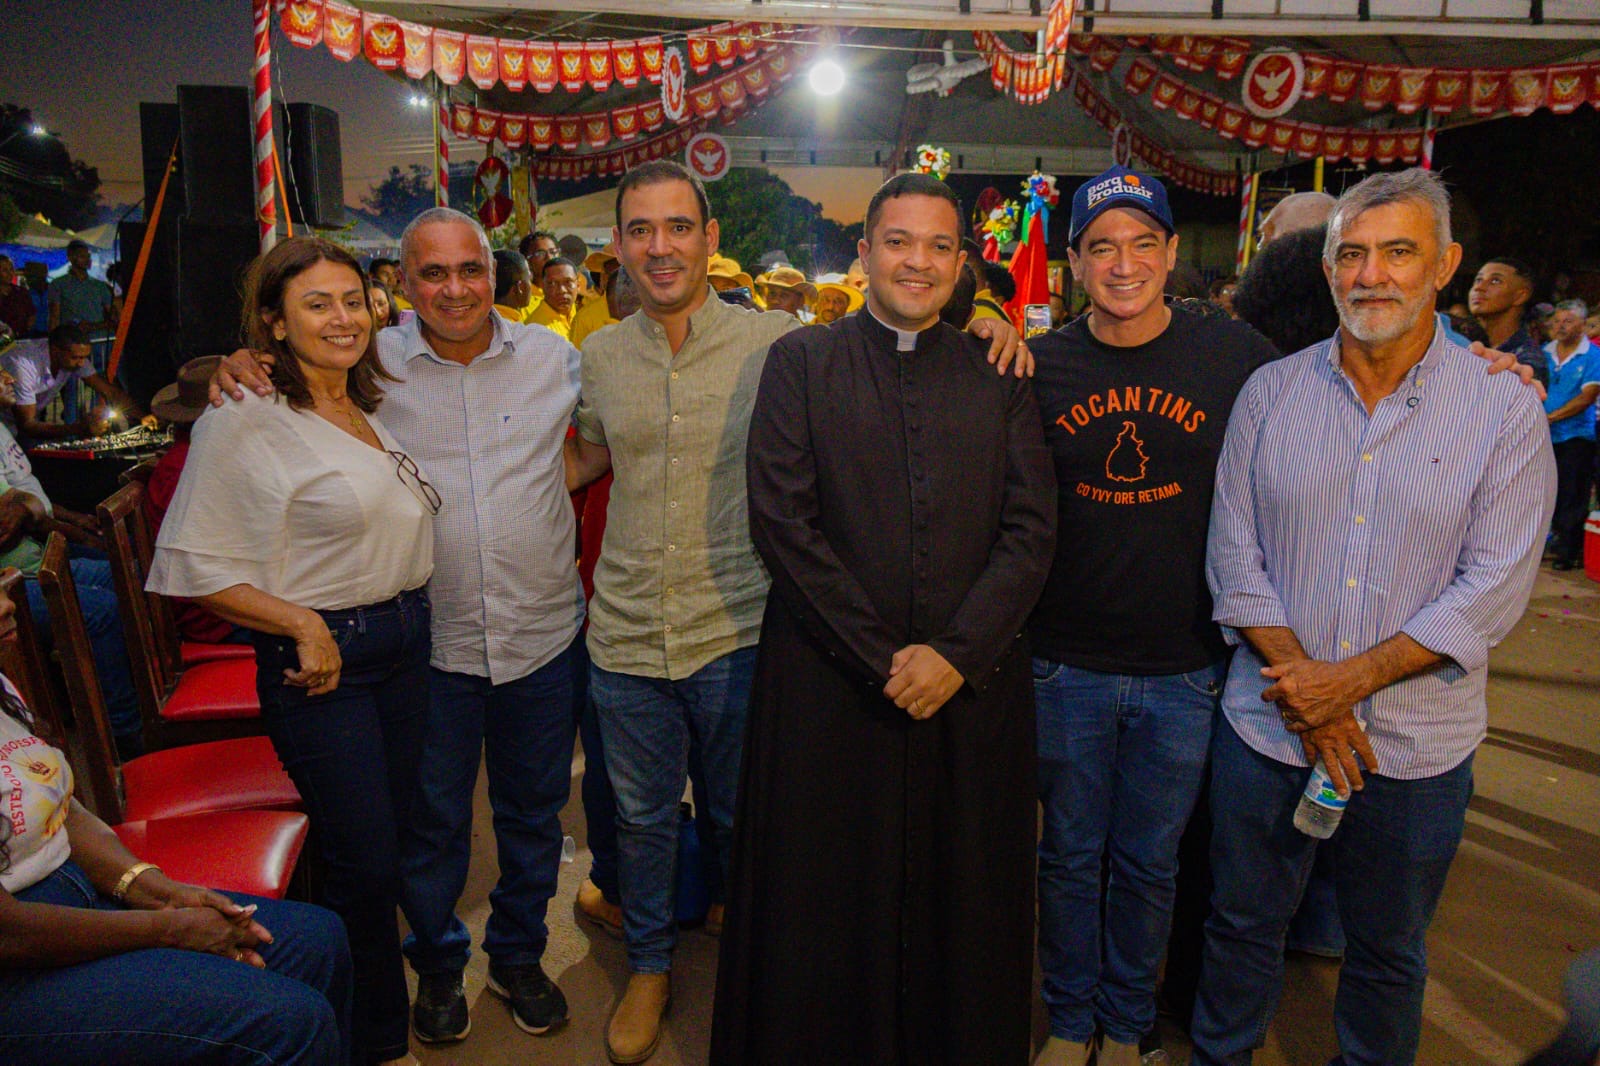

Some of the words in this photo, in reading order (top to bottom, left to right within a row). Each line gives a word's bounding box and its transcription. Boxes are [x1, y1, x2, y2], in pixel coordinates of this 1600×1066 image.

[1087, 176, 1122, 195] Bora
[1087, 183, 1154, 206] Produzir
[1055, 386, 1206, 434] TOCANTINS
[1076, 482, 1091, 497] CO
[1091, 487, 1113, 503] YVY
[1114, 491, 1136, 505] ORE
[1138, 482, 1183, 504] RETAMA
